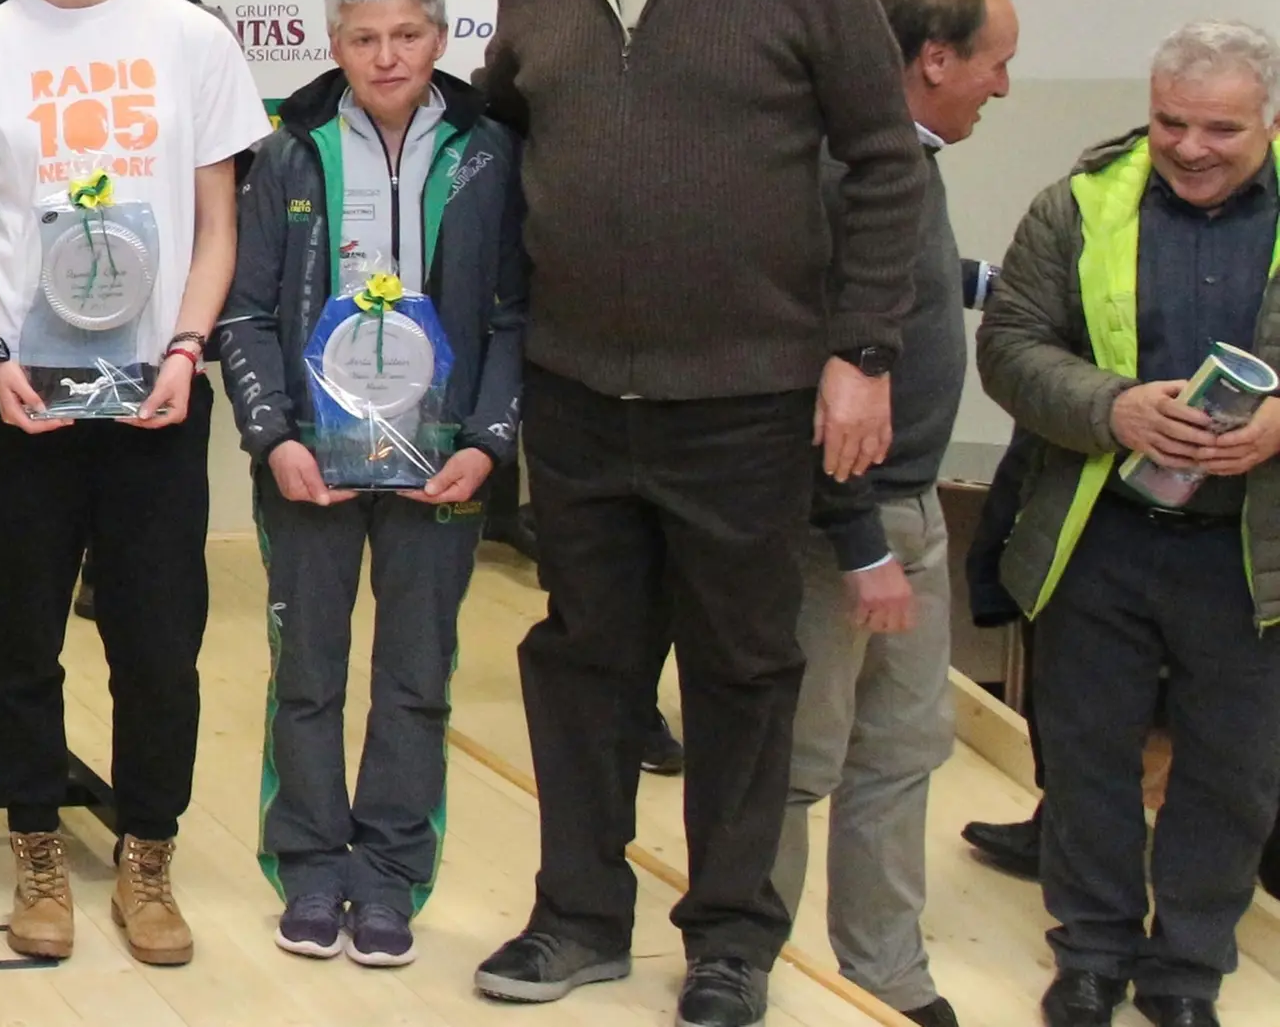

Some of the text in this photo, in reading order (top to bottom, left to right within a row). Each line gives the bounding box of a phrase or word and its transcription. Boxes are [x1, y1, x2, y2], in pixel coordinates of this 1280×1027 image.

[235, 4, 300, 18] GRUPPO
[243, 48, 332, 63] SSICURAZI
[30, 58, 157, 101] RADIO
[26, 94, 160, 159] 105
